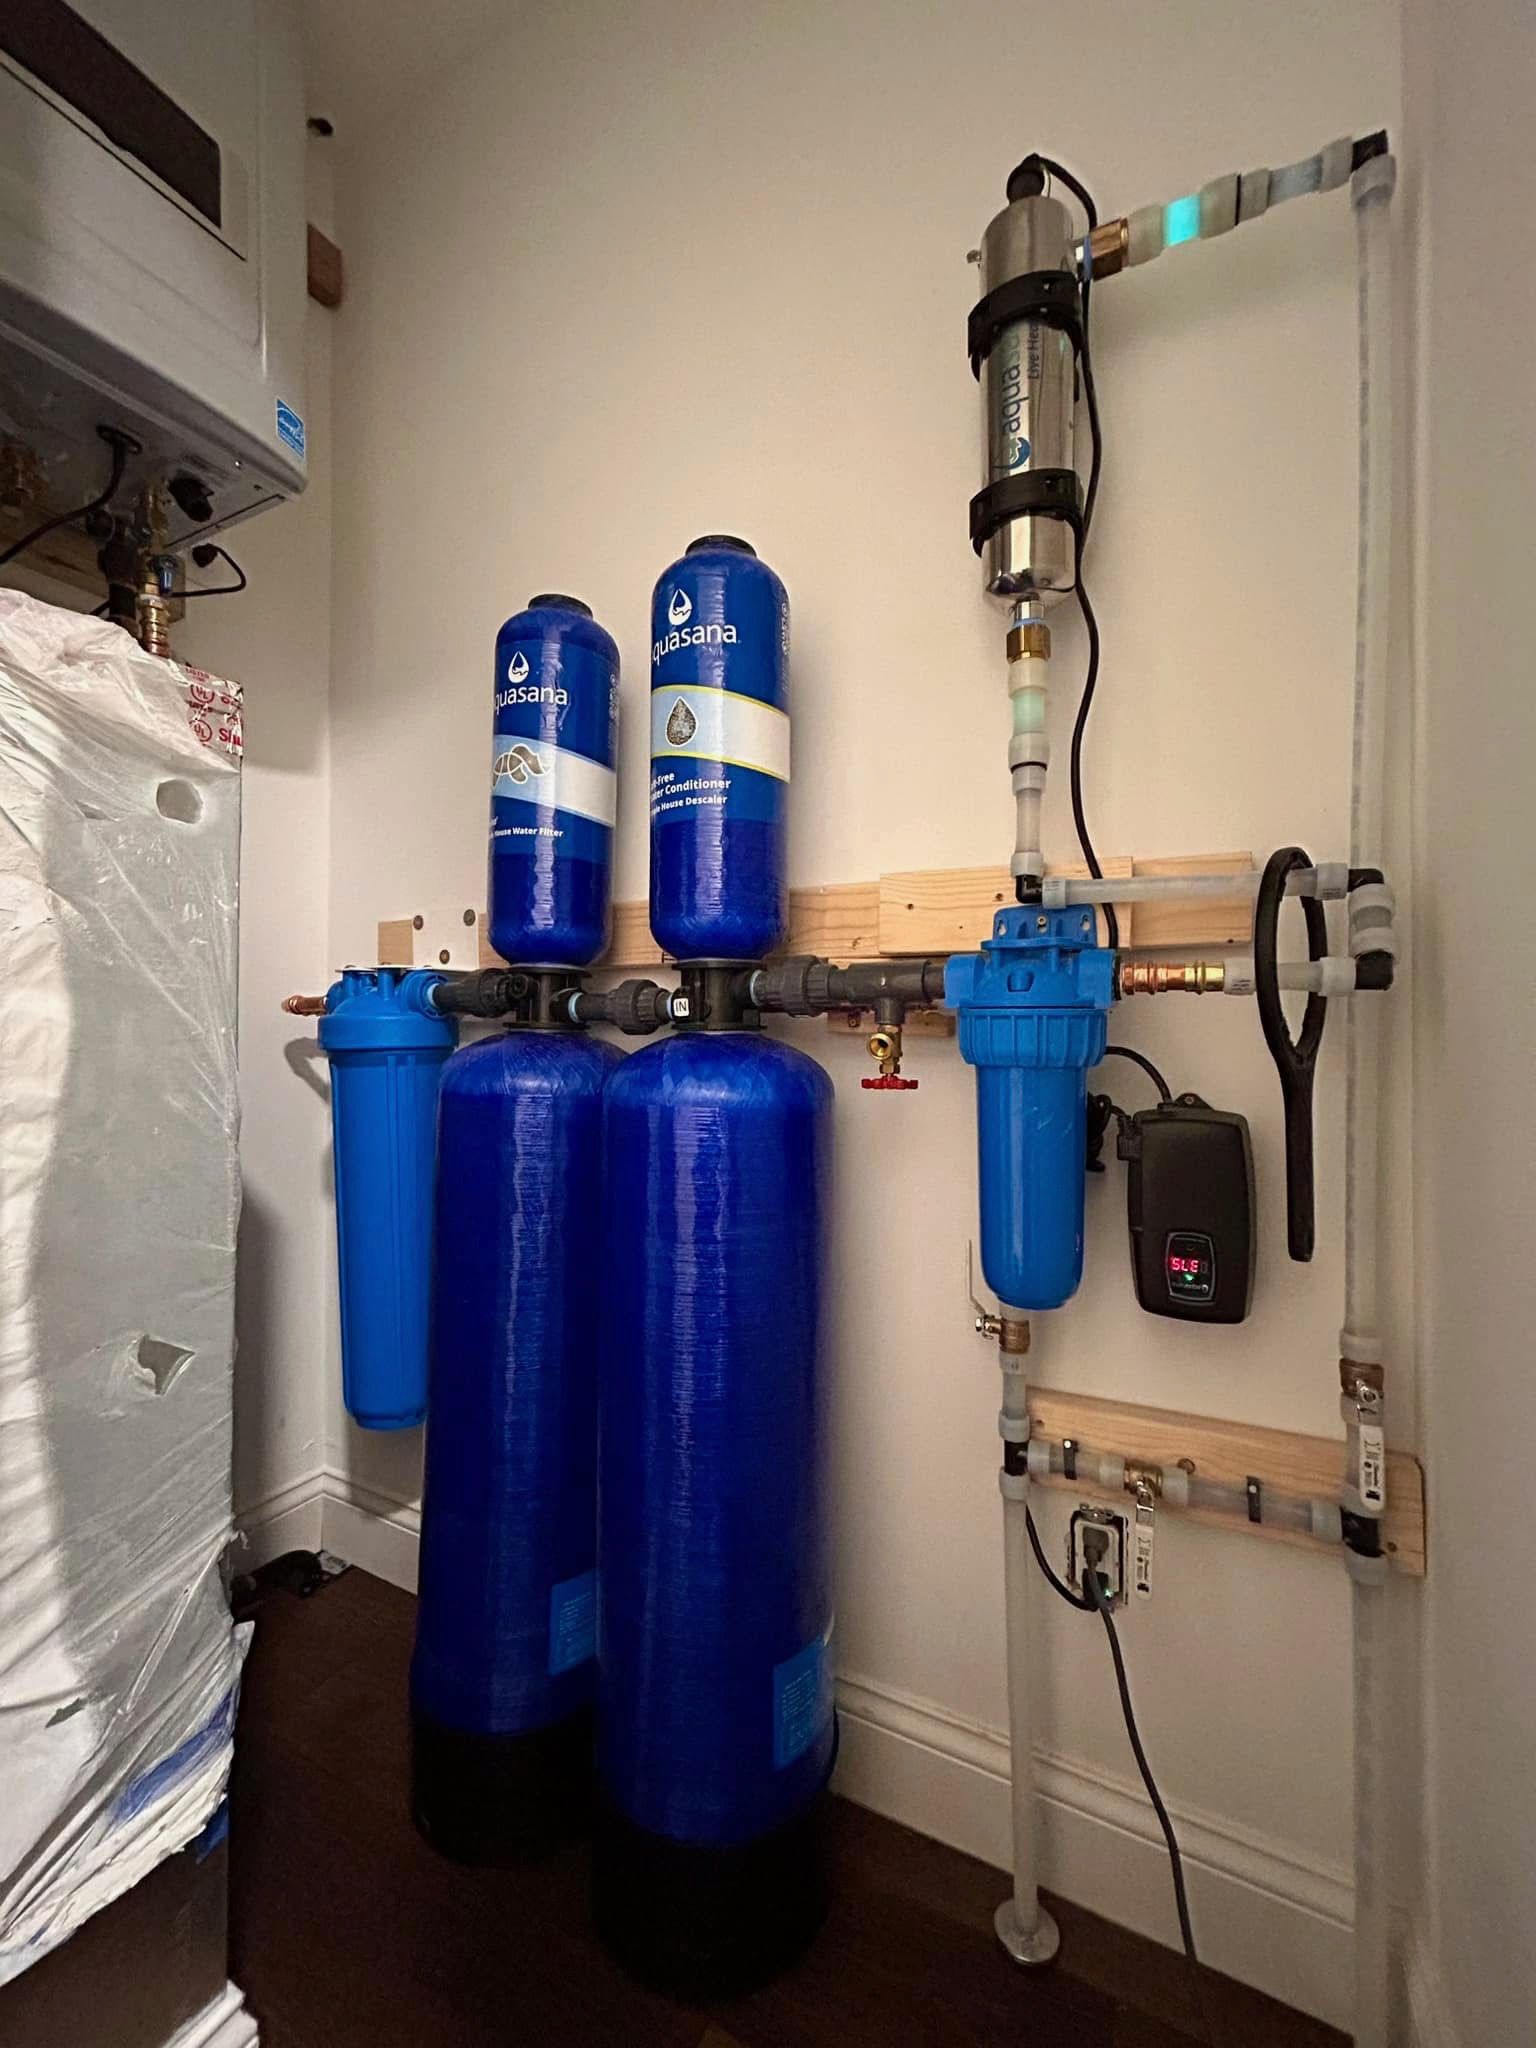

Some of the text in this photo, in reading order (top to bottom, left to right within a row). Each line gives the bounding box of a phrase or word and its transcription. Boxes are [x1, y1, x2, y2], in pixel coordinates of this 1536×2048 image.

[1001, 322, 1029, 434] aquasa
[653, 624, 737, 667] quasana
[495, 686, 568, 716] quasana
[665, 779, 732, 795] Conditioner
[661, 799, 684, 812] House
[685, 795, 728, 806] Descaler
[512, 827, 538, 835] Water
[539, 827, 564, 837] Filter
[675, 1000, 687, 1012] IN
